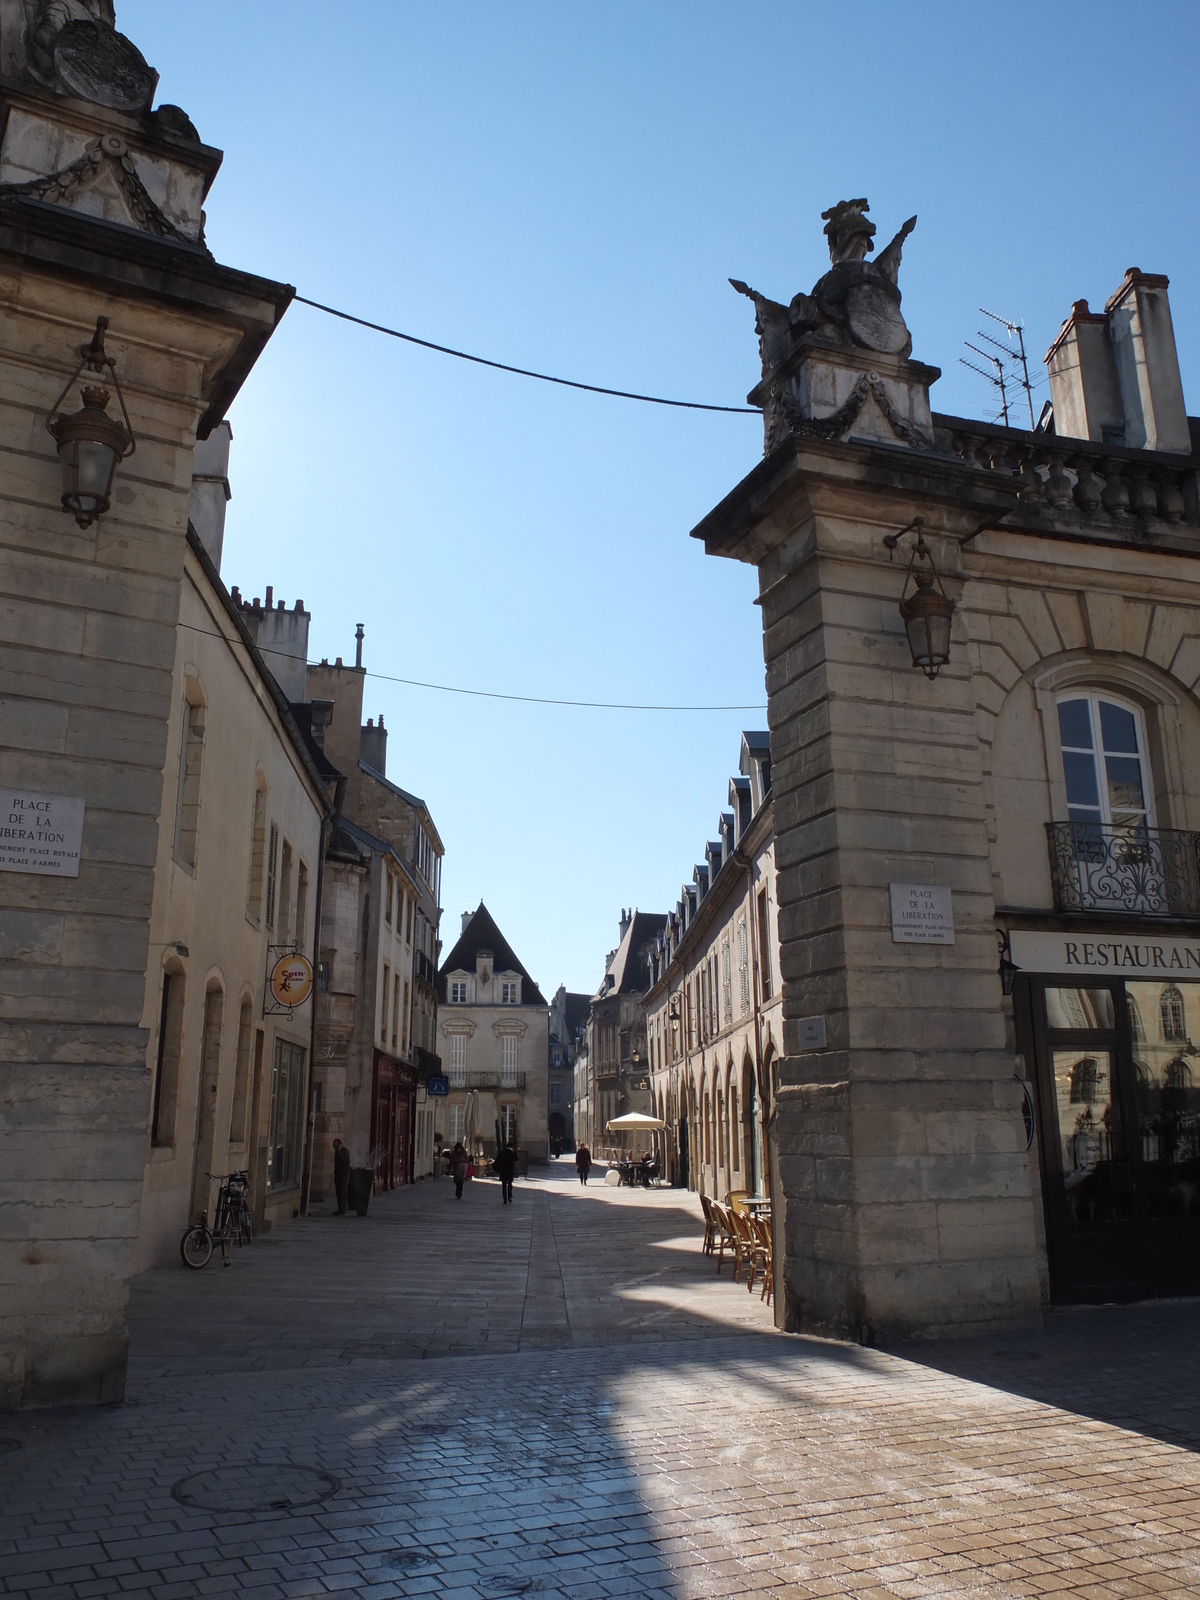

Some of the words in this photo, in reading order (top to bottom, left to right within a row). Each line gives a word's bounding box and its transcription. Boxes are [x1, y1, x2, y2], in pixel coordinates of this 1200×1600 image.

[13, 799, 52, 812] PLACE
[9, 814, 25, 824] DE
[36, 816, 52, 827] LA
[0, 828, 64, 842] IBERATION
[53, 850, 79, 858] ROYALE
[910, 890, 932, 898] PLACE
[902, 911, 944, 920] LIBERATION
